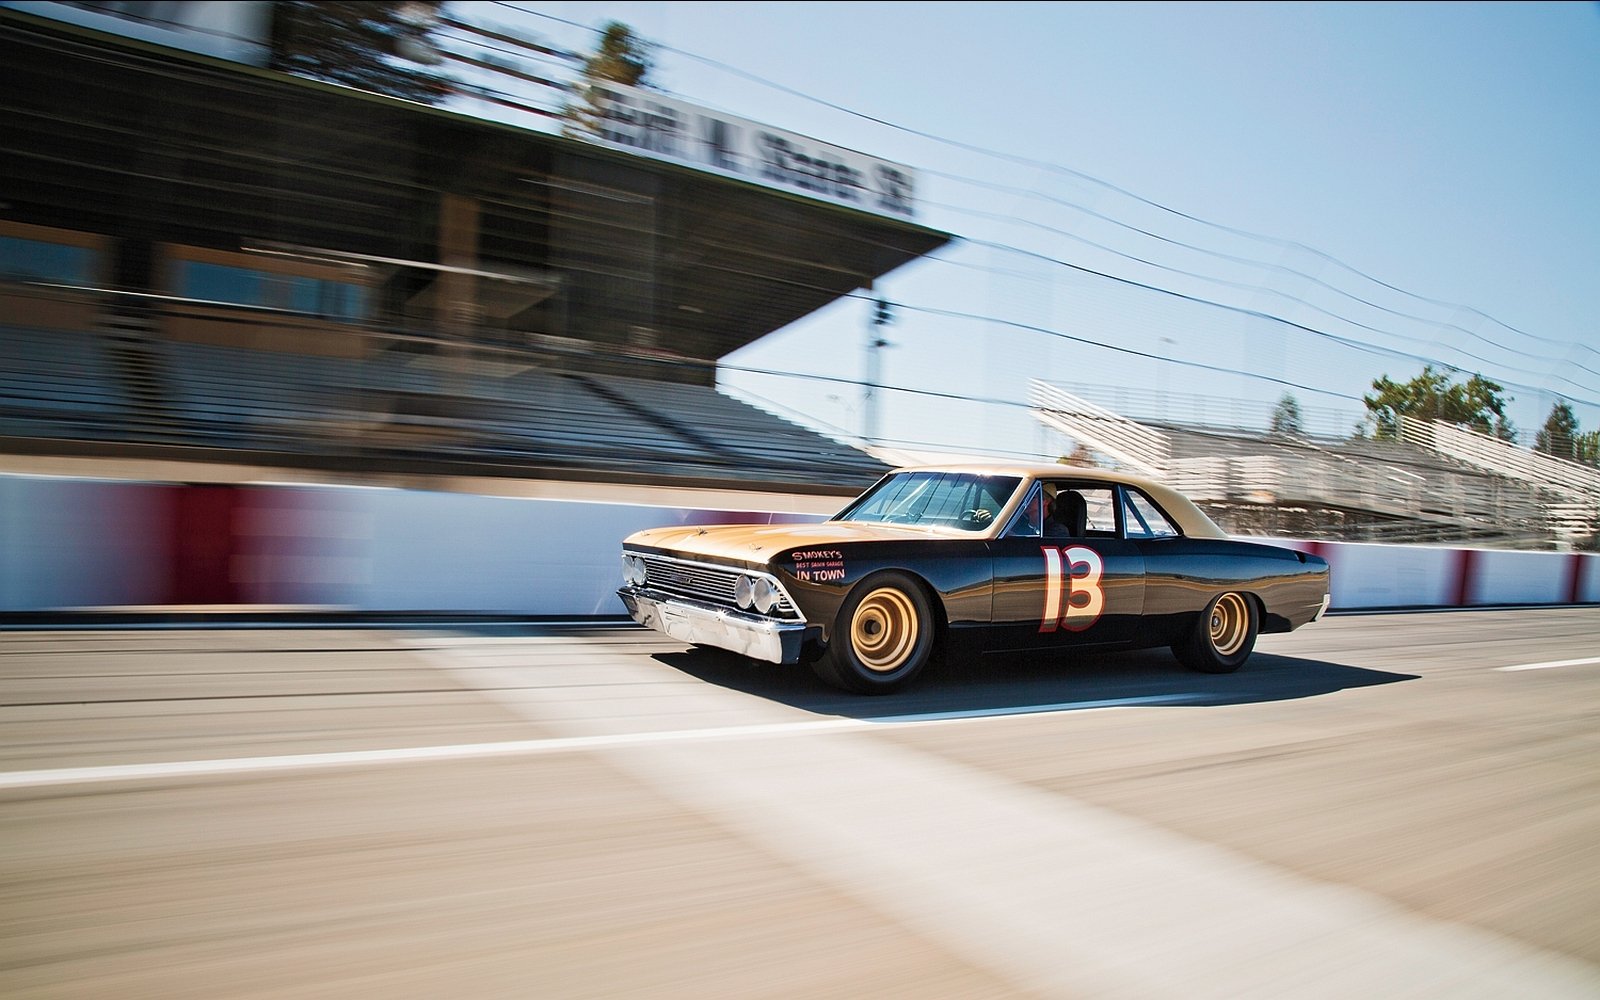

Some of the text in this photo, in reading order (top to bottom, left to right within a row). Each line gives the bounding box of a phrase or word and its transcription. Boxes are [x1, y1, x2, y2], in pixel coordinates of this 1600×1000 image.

[792, 550, 843, 561] SMOKEY'S
[796, 561, 810, 569] BEST
[797, 569, 845, 581] IN TOWN
[1039, 544, 1106, 632] 13
